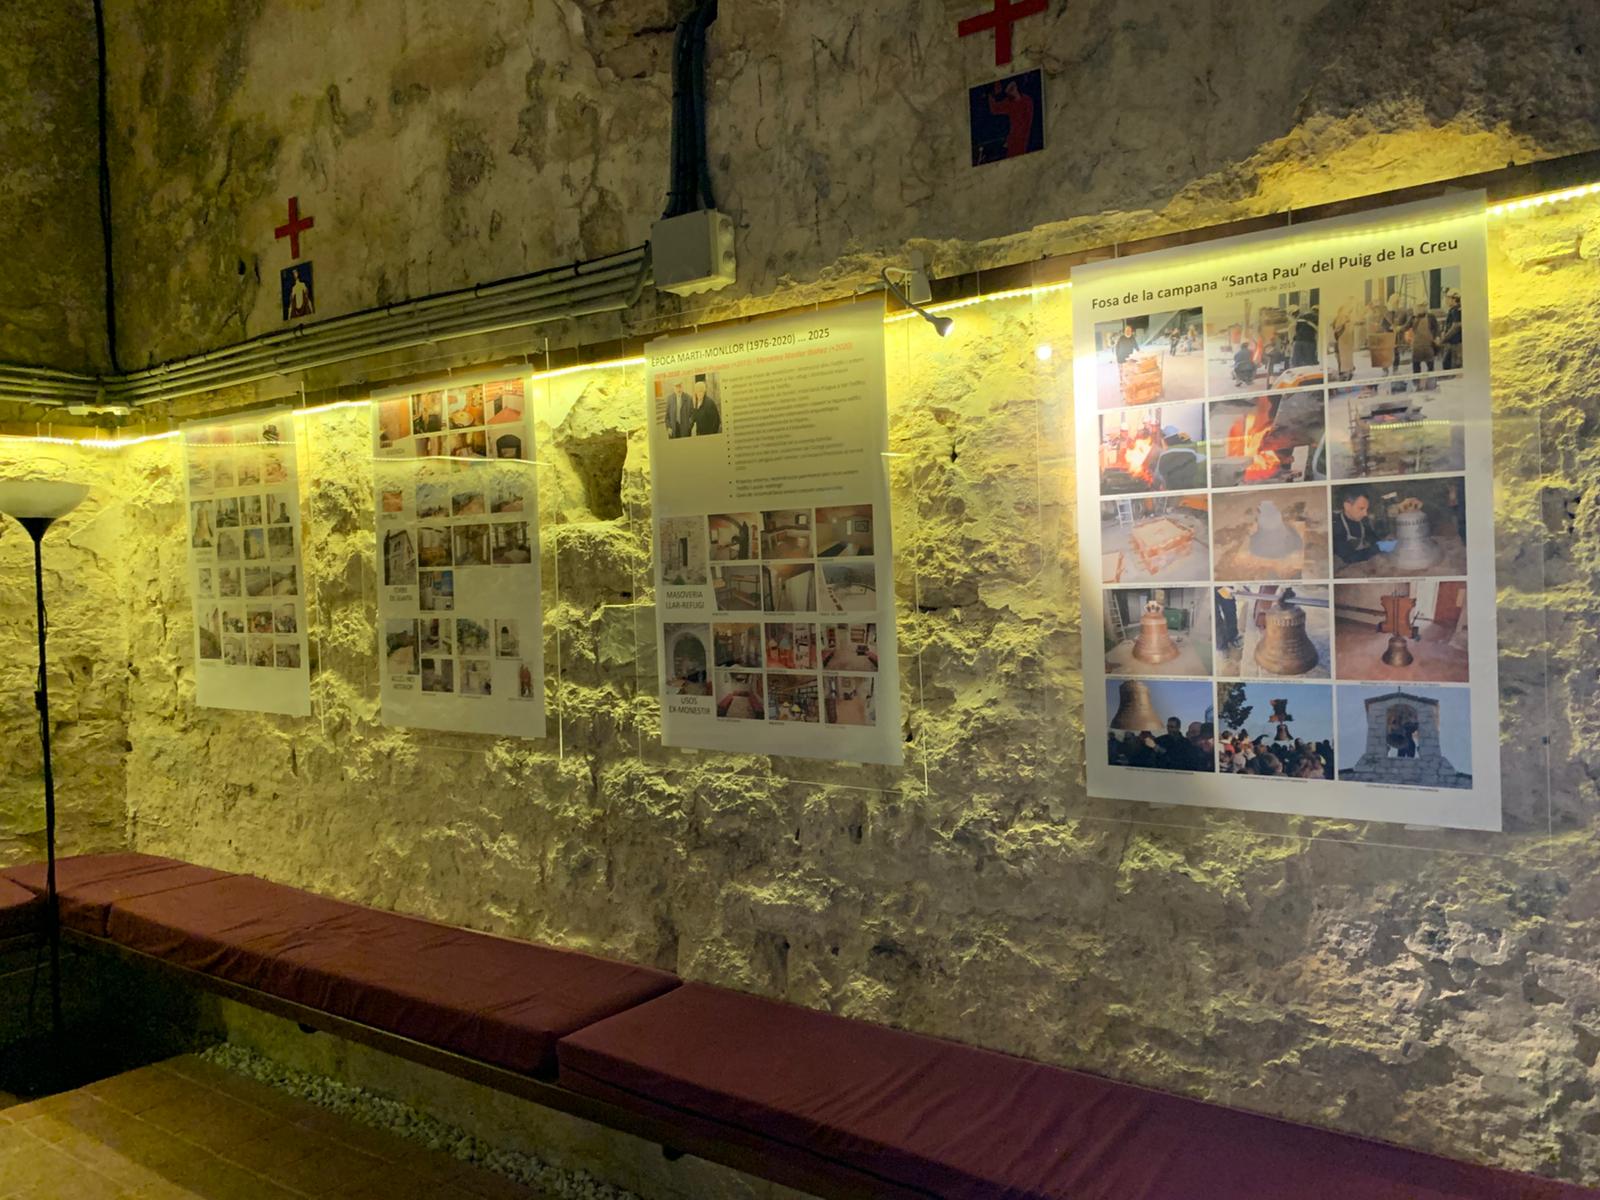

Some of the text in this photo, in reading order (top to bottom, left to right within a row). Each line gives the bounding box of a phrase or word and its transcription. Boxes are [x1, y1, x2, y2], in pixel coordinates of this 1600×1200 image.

[1092, 239, 1458, 310] Fosa de la campana “Santa Pau” del Puig de la Creu
[746, 333, 796, 354] (1976-2020)
[808, 327, 831, 342] 2025
[680, 696, 698, 706] USOS
